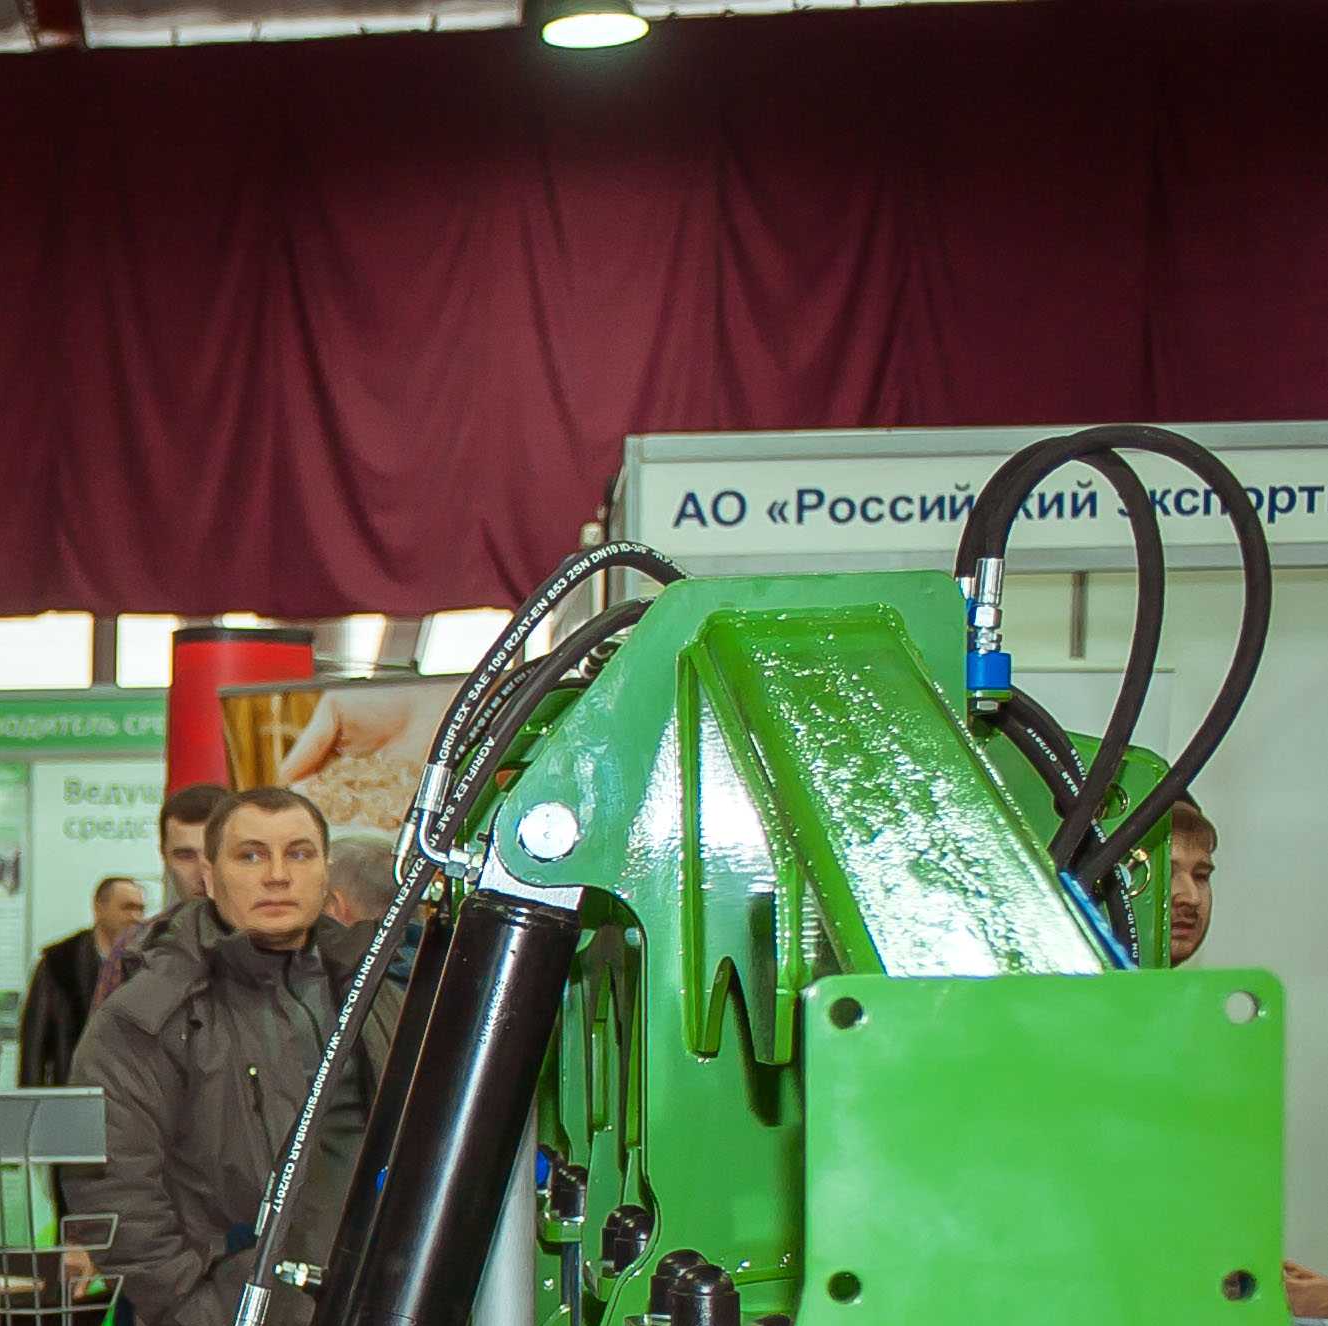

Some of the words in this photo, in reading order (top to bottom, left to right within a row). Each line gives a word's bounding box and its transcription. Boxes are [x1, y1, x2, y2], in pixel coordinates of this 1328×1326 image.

[674, 489, 747, 527] АО
[766, 480, 1098, 525] «Российкий
[1117, 484, 1328, 525] кспорт
[470, 674, 491, 700] SAE
[488, 651, 507, 674] 100
[504, 597, 550, 653] R2AT-EN
[546, 578, 568, 600] 853
[566, 558, 591, 582] 2SN
[589, 543, 619, 564] DN10
[453, 736, 496, 803] AGRIFLEX
[62, 815, 159, 845] средс
[440, 804, 456, 831] SAE
[427, 826, 443, 848] 10
[388, 904, 404, 929] 853
[373, 927, 390, 955] 2SN
[354, 954, 377, 988] DN10
[273, 1164, 297, 1215] Q3/2017
